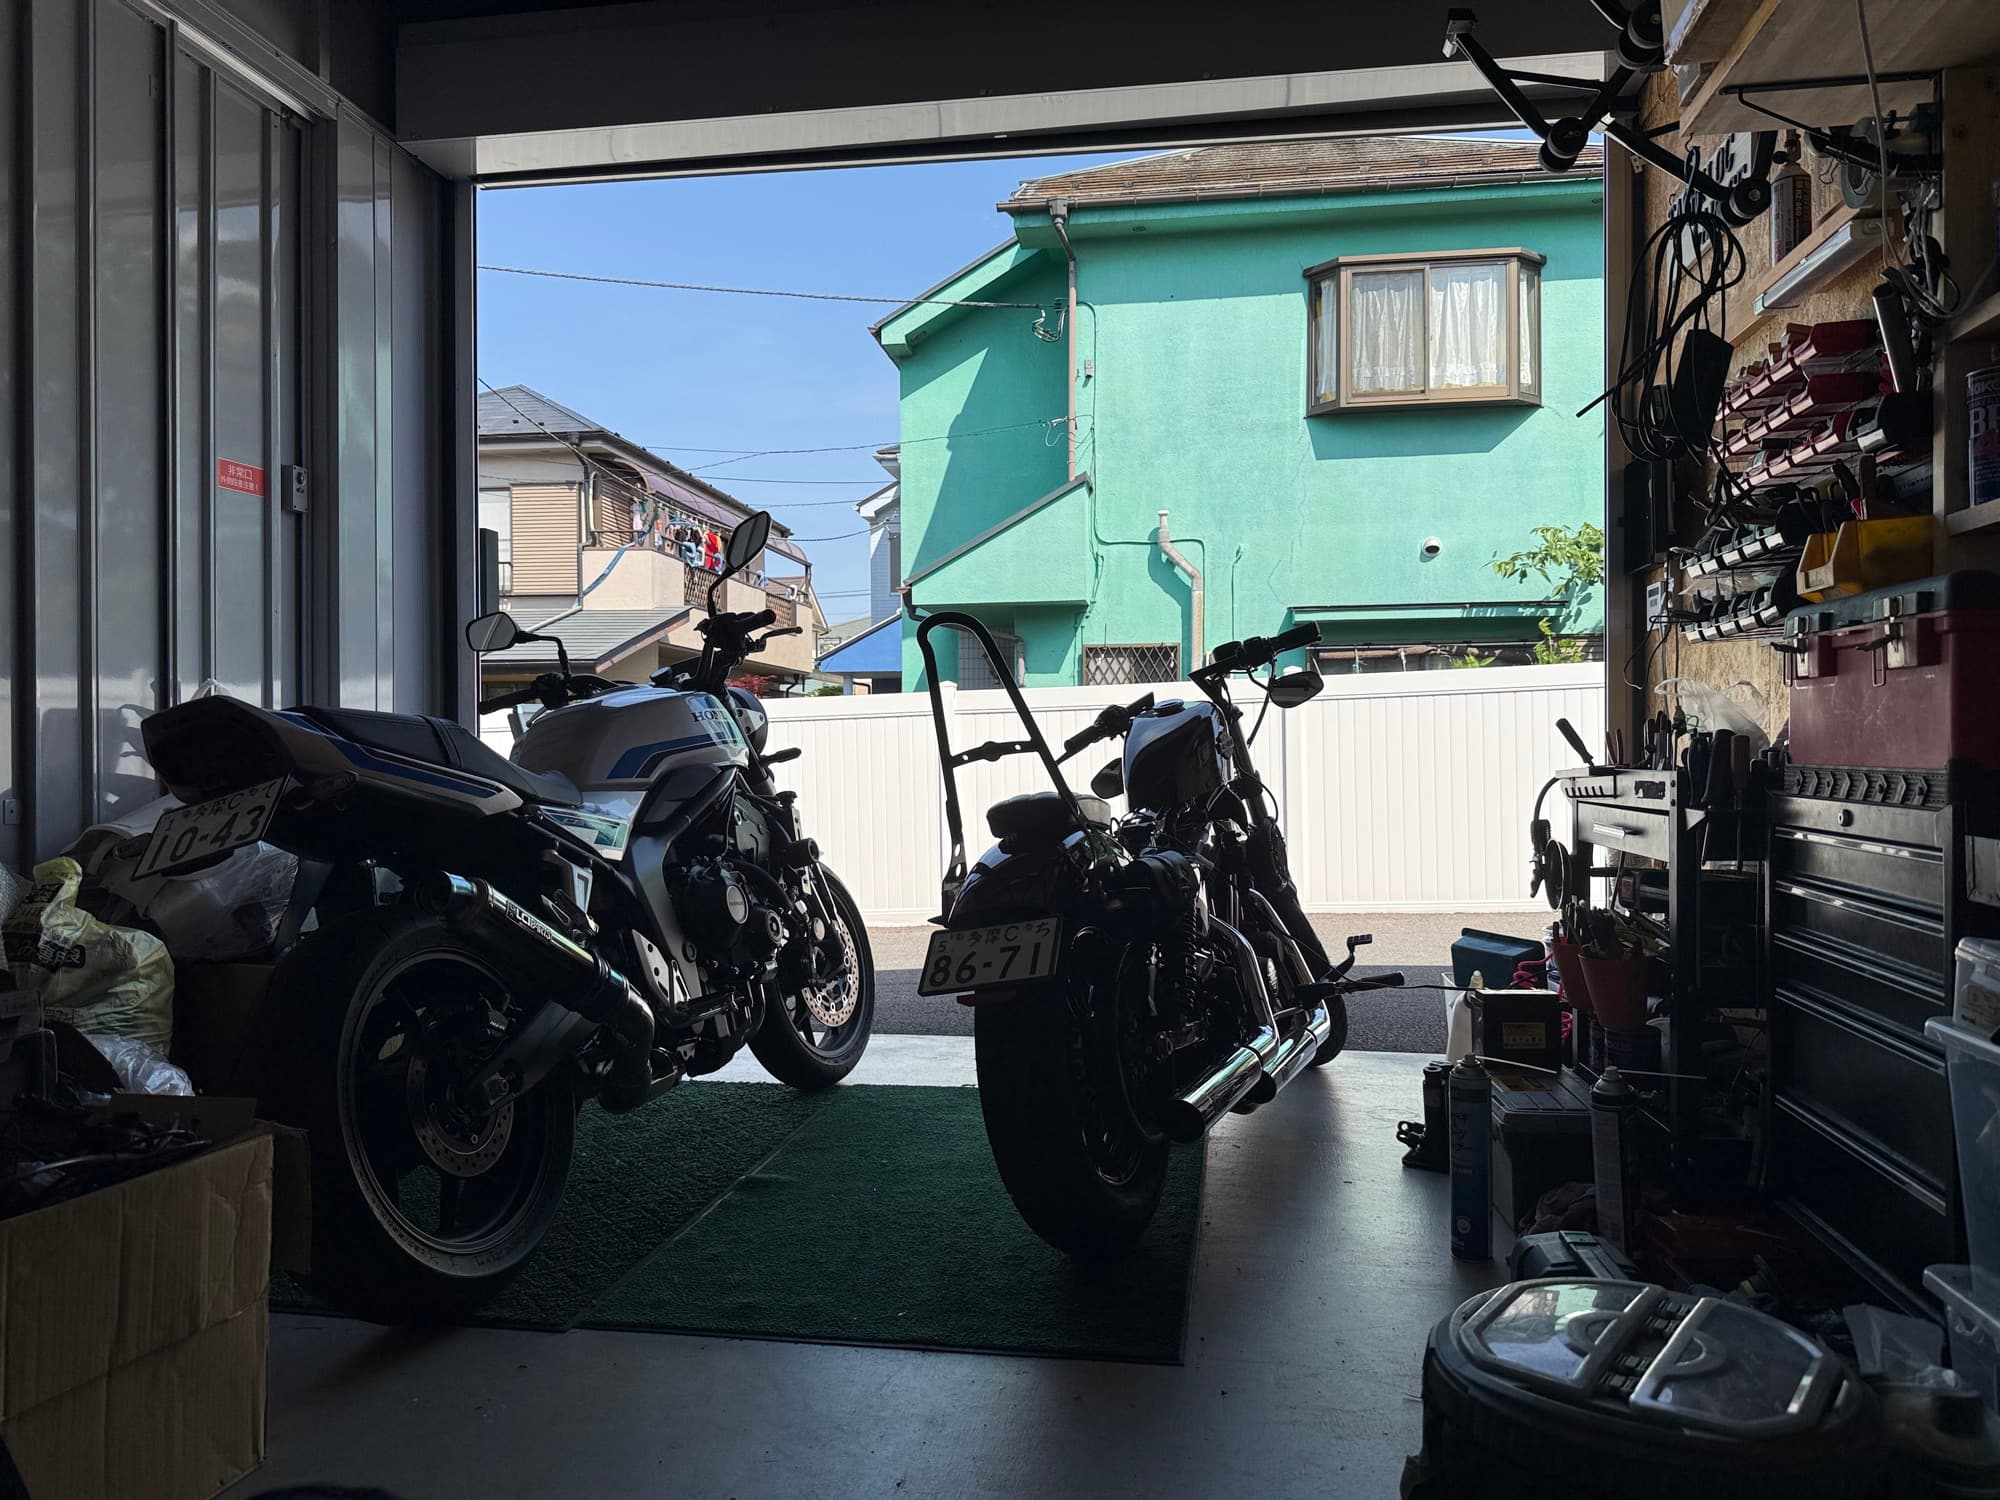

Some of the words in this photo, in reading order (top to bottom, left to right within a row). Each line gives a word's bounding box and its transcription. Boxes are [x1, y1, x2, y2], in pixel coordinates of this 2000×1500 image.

[227, 464, 253, 481] 非常口
[147, 804, 266, 871] 10-43
[929, 942, 1041, 987] 86-71
